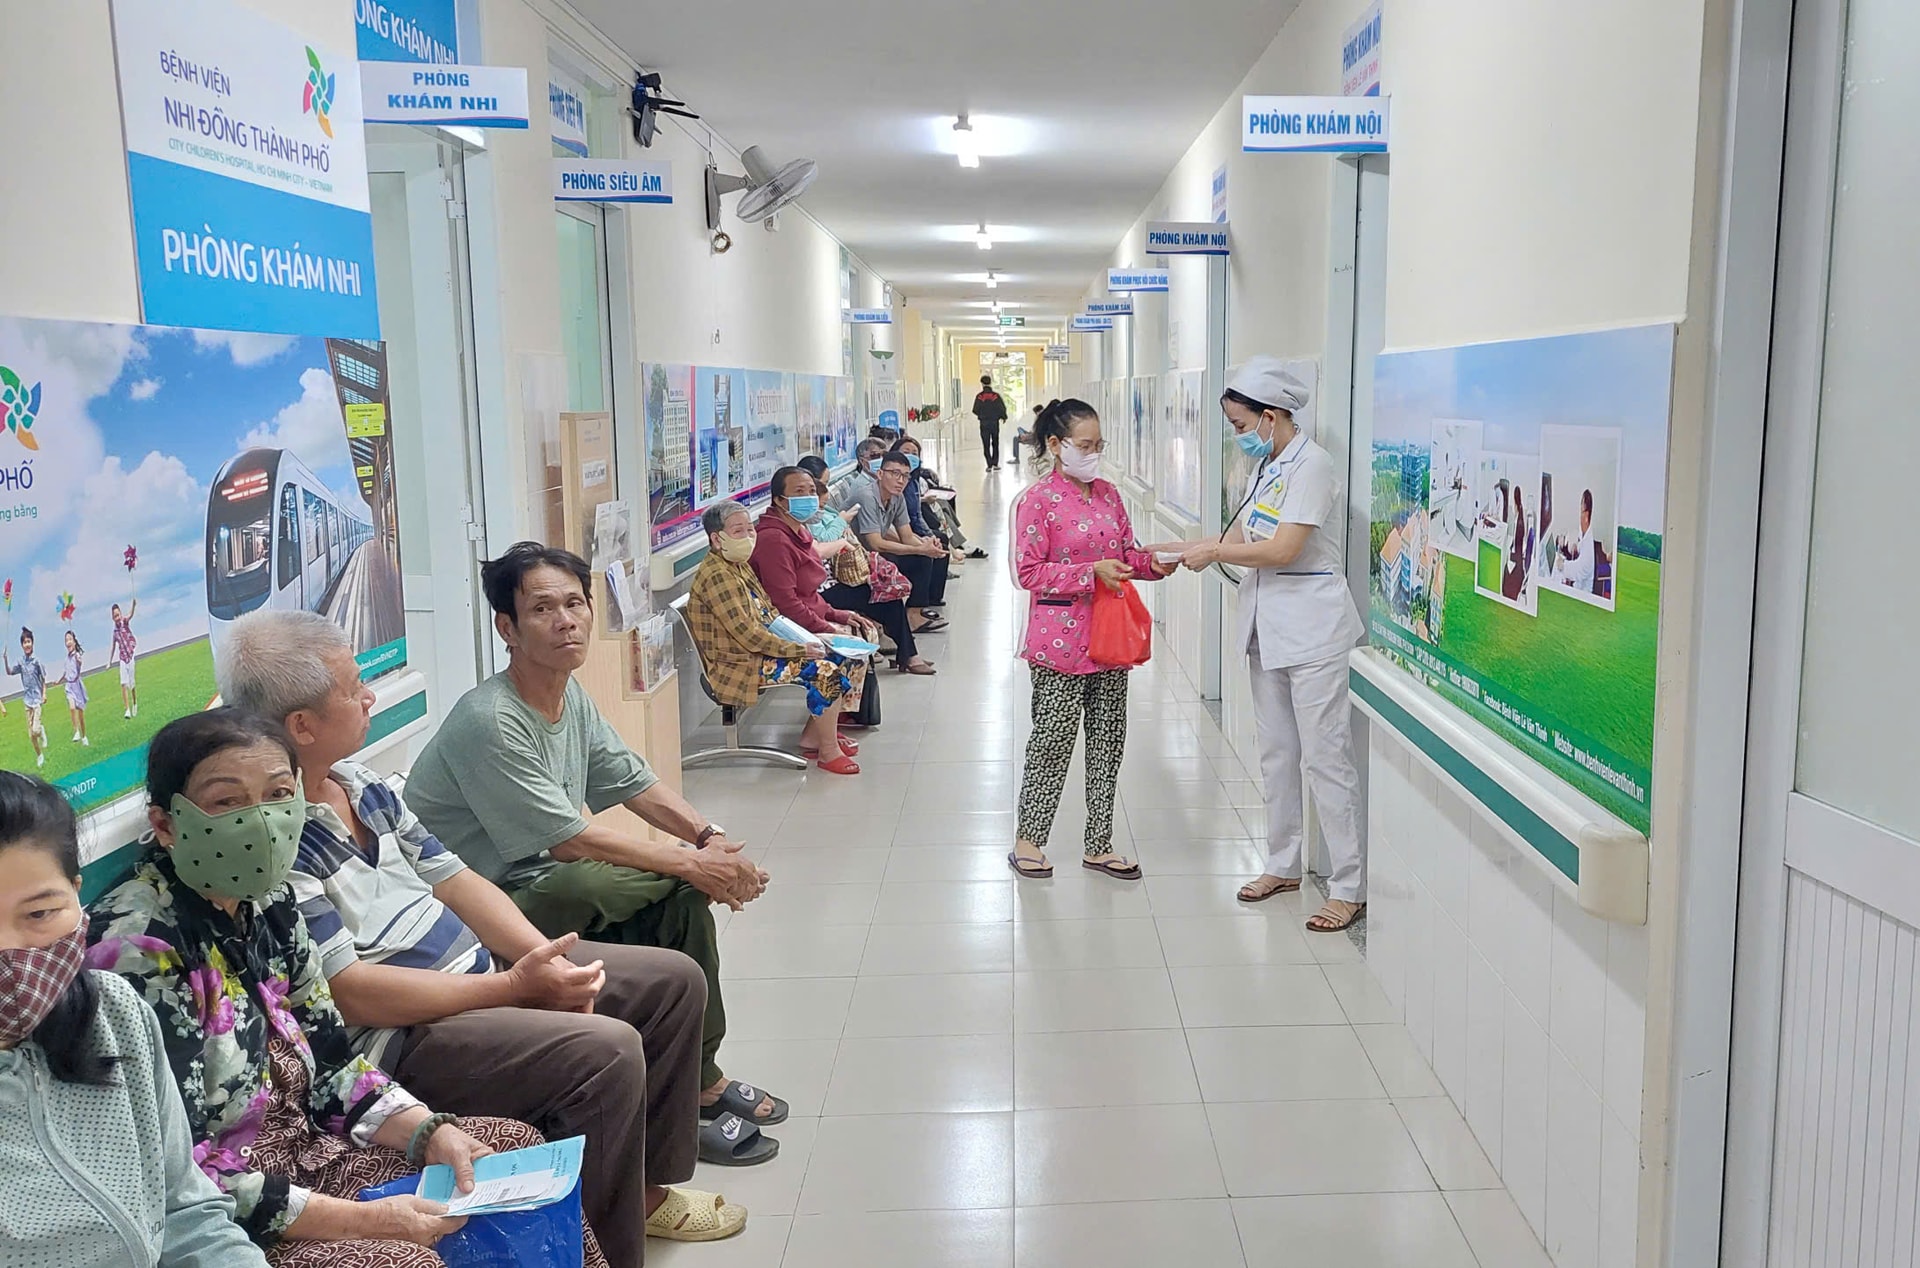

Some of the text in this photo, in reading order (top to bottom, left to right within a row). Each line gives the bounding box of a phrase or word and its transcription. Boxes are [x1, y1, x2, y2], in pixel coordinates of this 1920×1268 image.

[390, 13, 431, 64] KHÁM
[160, 49, 231, 98] BỆNH VIỆN
[413, 69, 470, 87] PHÒNG
[387, 92, 498, 111] KHÁM NHI
[164, 96, 330, 173] NHI ĐỒNG THÀNH PHỐ
[1249, 108, 1382, 139] PHÒNG KHÁM NỘI
[168, 137, 185, 151] CITY
[292, 173, 304, 186] CITY
[309, 178, 333, 193] VIETNAM
[562, 169, 662, 192] PHÒNG SIÊU ÂM
[1149, 229, 1227, 249] PHÒNG KHÁM NỘI
[162, 222, 362, 297] PHÒNG KHÁM NHI
[0, 503, 38, 522] ng bằng
